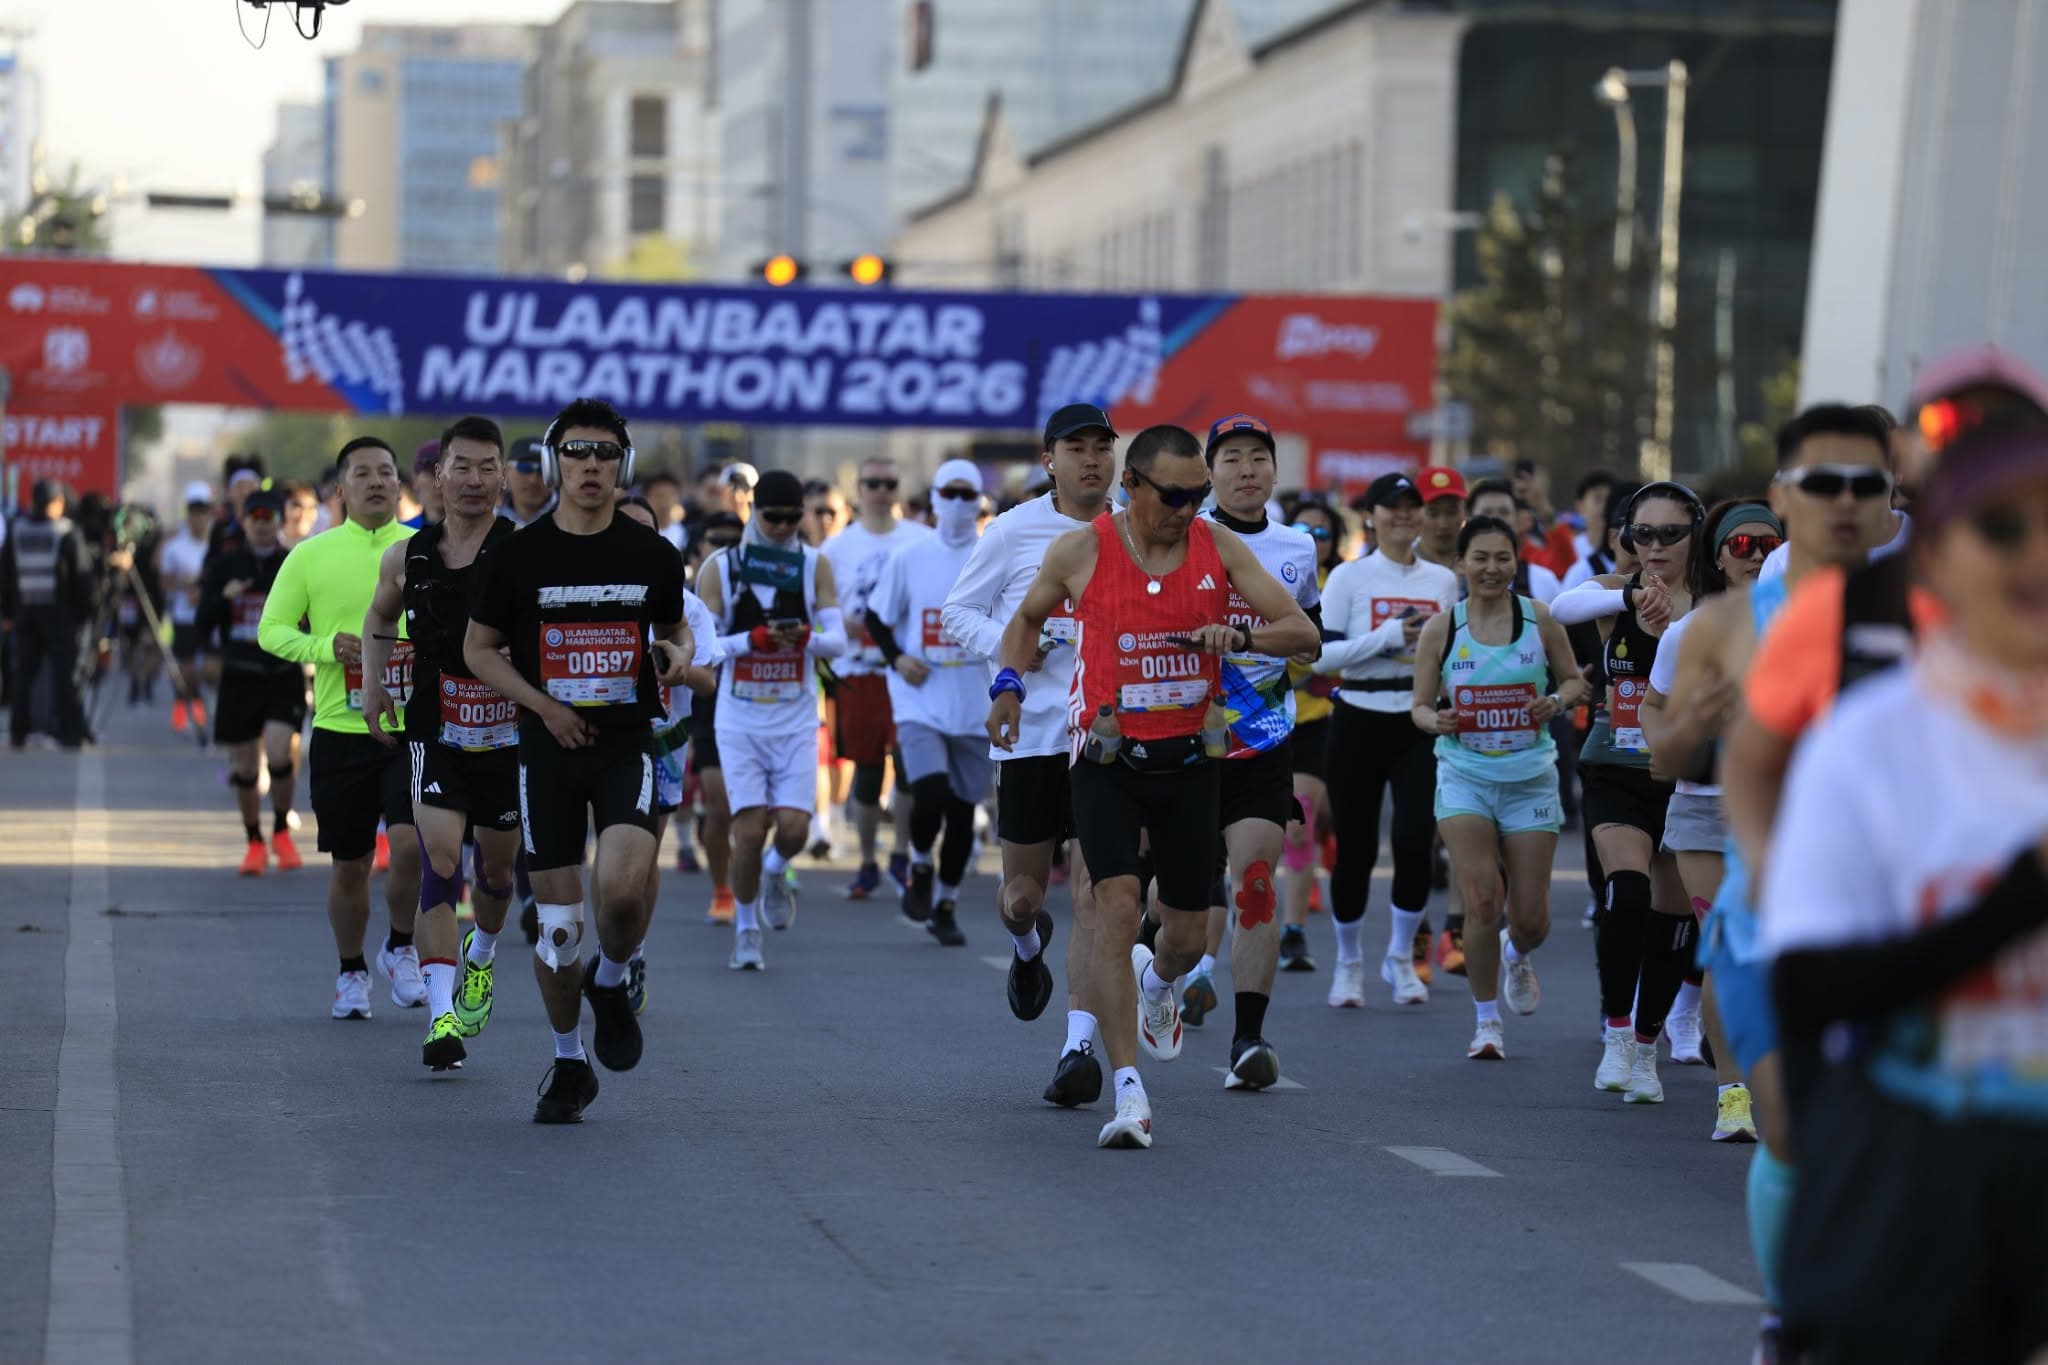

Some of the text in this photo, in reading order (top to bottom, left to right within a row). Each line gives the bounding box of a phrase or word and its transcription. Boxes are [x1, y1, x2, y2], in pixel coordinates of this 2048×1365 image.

[465, 292, 984, 357] ULAANBAATAR
[418, 346, 1028, 416] MARATHON 2026
[4, 414, 103, 450] START
[565, 628, 625, 637] ULAANBAATAR
[1138, 631, 1193, 642] ULAANBAATA
[565, 636, 635, 646] MARATHON 2026
[1138, 640, 1179, 650] MARATHO
[568, 651, 634, 674] 00597
[1120, 657, 1138, 665] 42KM
[1141, 653, 1200, 679] 00110
[1452, 661, 1475, 670] ELITE
[1610, 658, 1635, 671] ELITE
[752, 662, 797, 679] 00281
[458, 690, 496, 699] MARATHO
[460, 700, 517, 723] 00305
[1476, 708, 1530, 728] 00176
